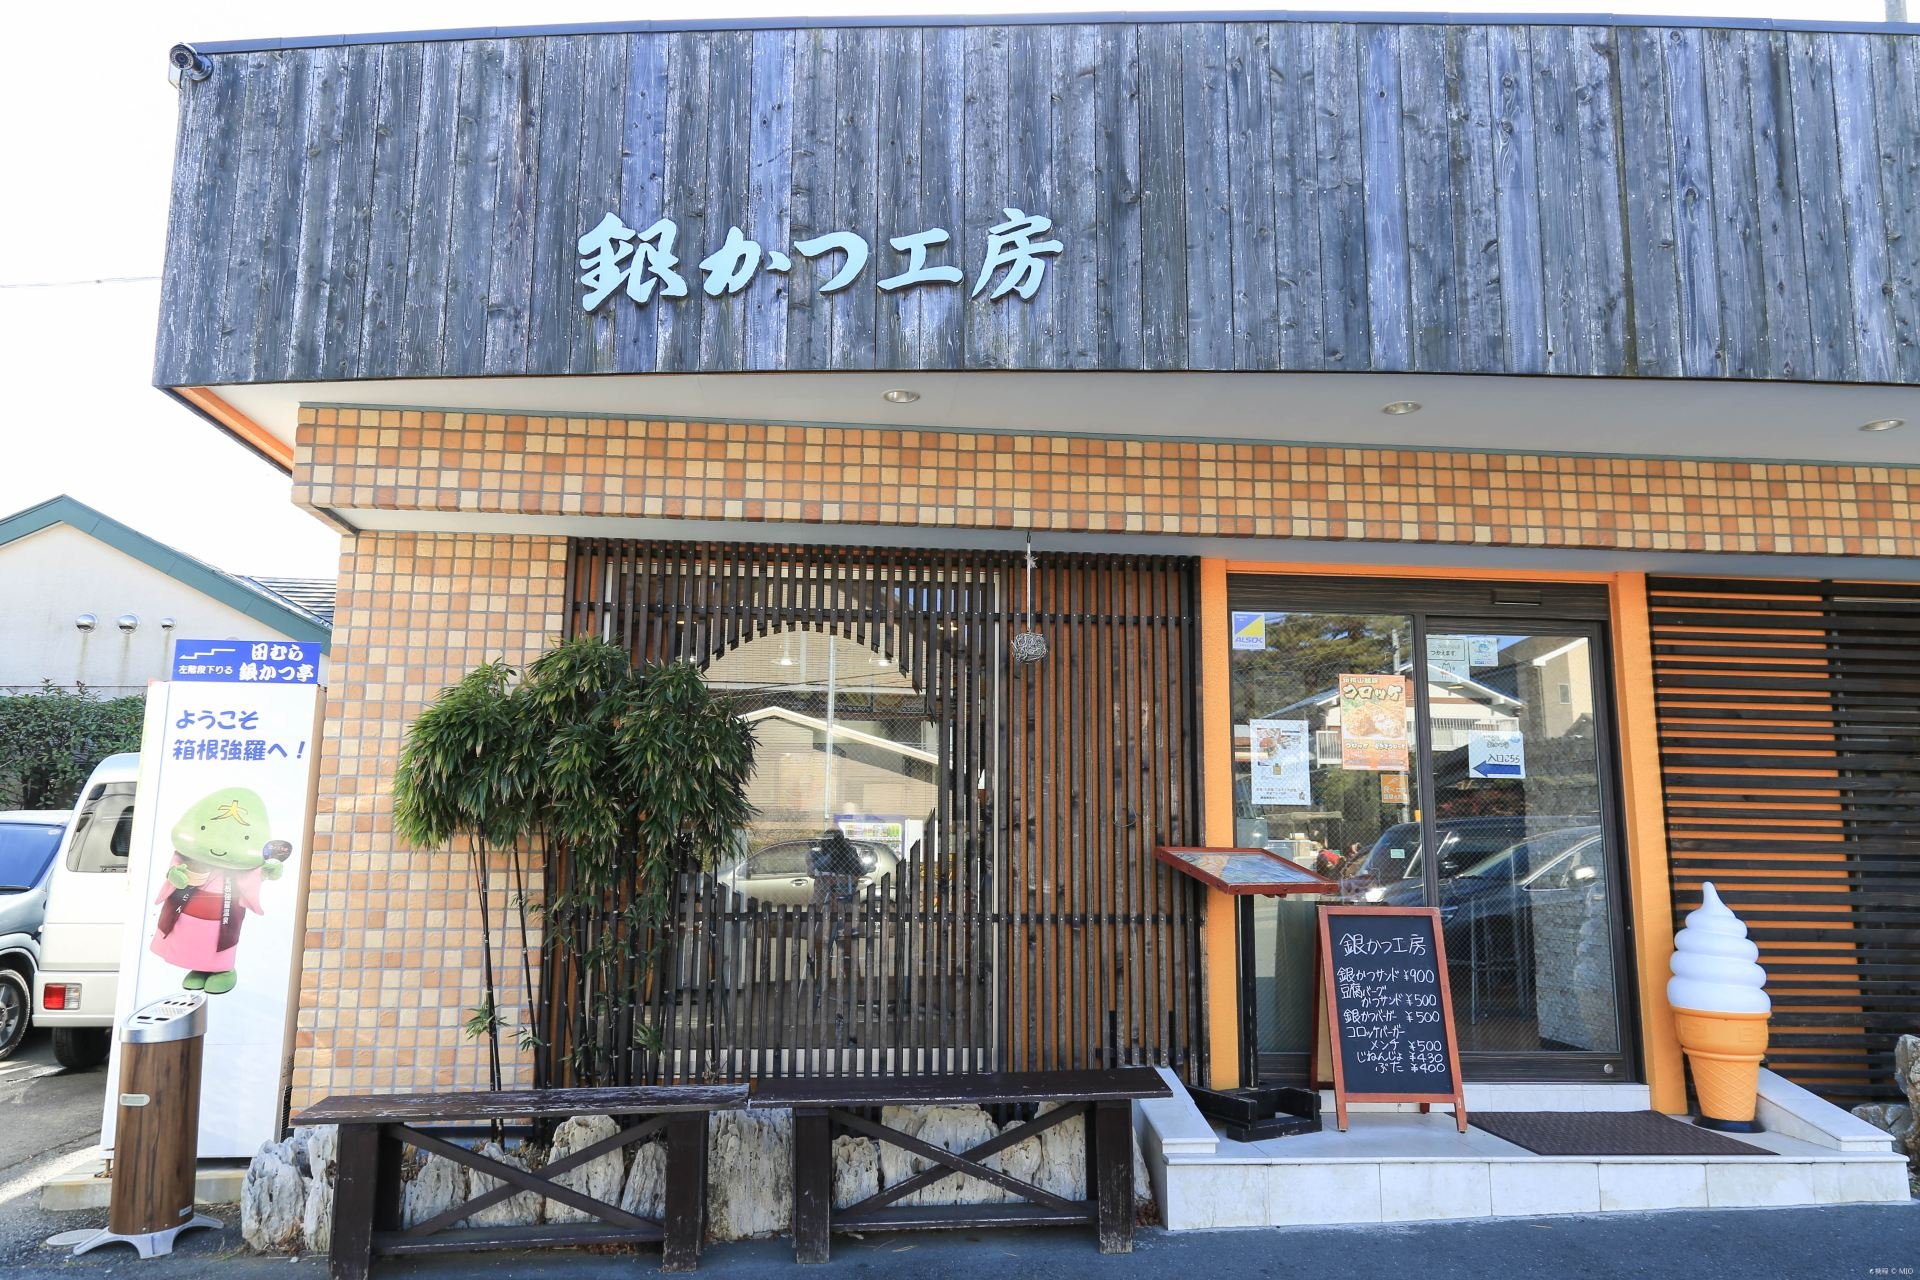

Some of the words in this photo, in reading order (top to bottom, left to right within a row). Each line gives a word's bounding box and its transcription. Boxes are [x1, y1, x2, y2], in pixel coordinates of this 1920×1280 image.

[577, 207, 1065, 314] 銀かつ工房
[251, 642, 304, 662] 田むら
[238, 662, 315, 682] 銀かつ亭
[1342, 683, 1403, 702] コロッケ
[175, 709, 259, 731] ようこそ
[1487, 753, 1521, 764] 入口こちら
[1339, 932, 1427, 957] 銀かつ工房
[1336, 966, 1400, 984] 銀かつサンド
[1403, 969, 1435, 984] ¥900
[1361, 993, 1402, 1009] かつサンド
[1405, 994, 1437, 1007] ¥500
[1343, 1008, 1398, 1024] 銀かつバーガー
[1405, 1010, 1440, 1024] ¥500
[1345, 1023, 1406, 1039] コロッケバーガー
[1370, 1038, 1400, 1051] メンチ
[1408, 1040, 1442, 1052] ¥500
[1356, 1050, 1404, 1063] じねんじょ
[1409, 1051, 1444, 1064] ¥430
[1375, 1062, 1404, 1074] ぶた
[1410, 1062, 1446, 1074] ¥400
